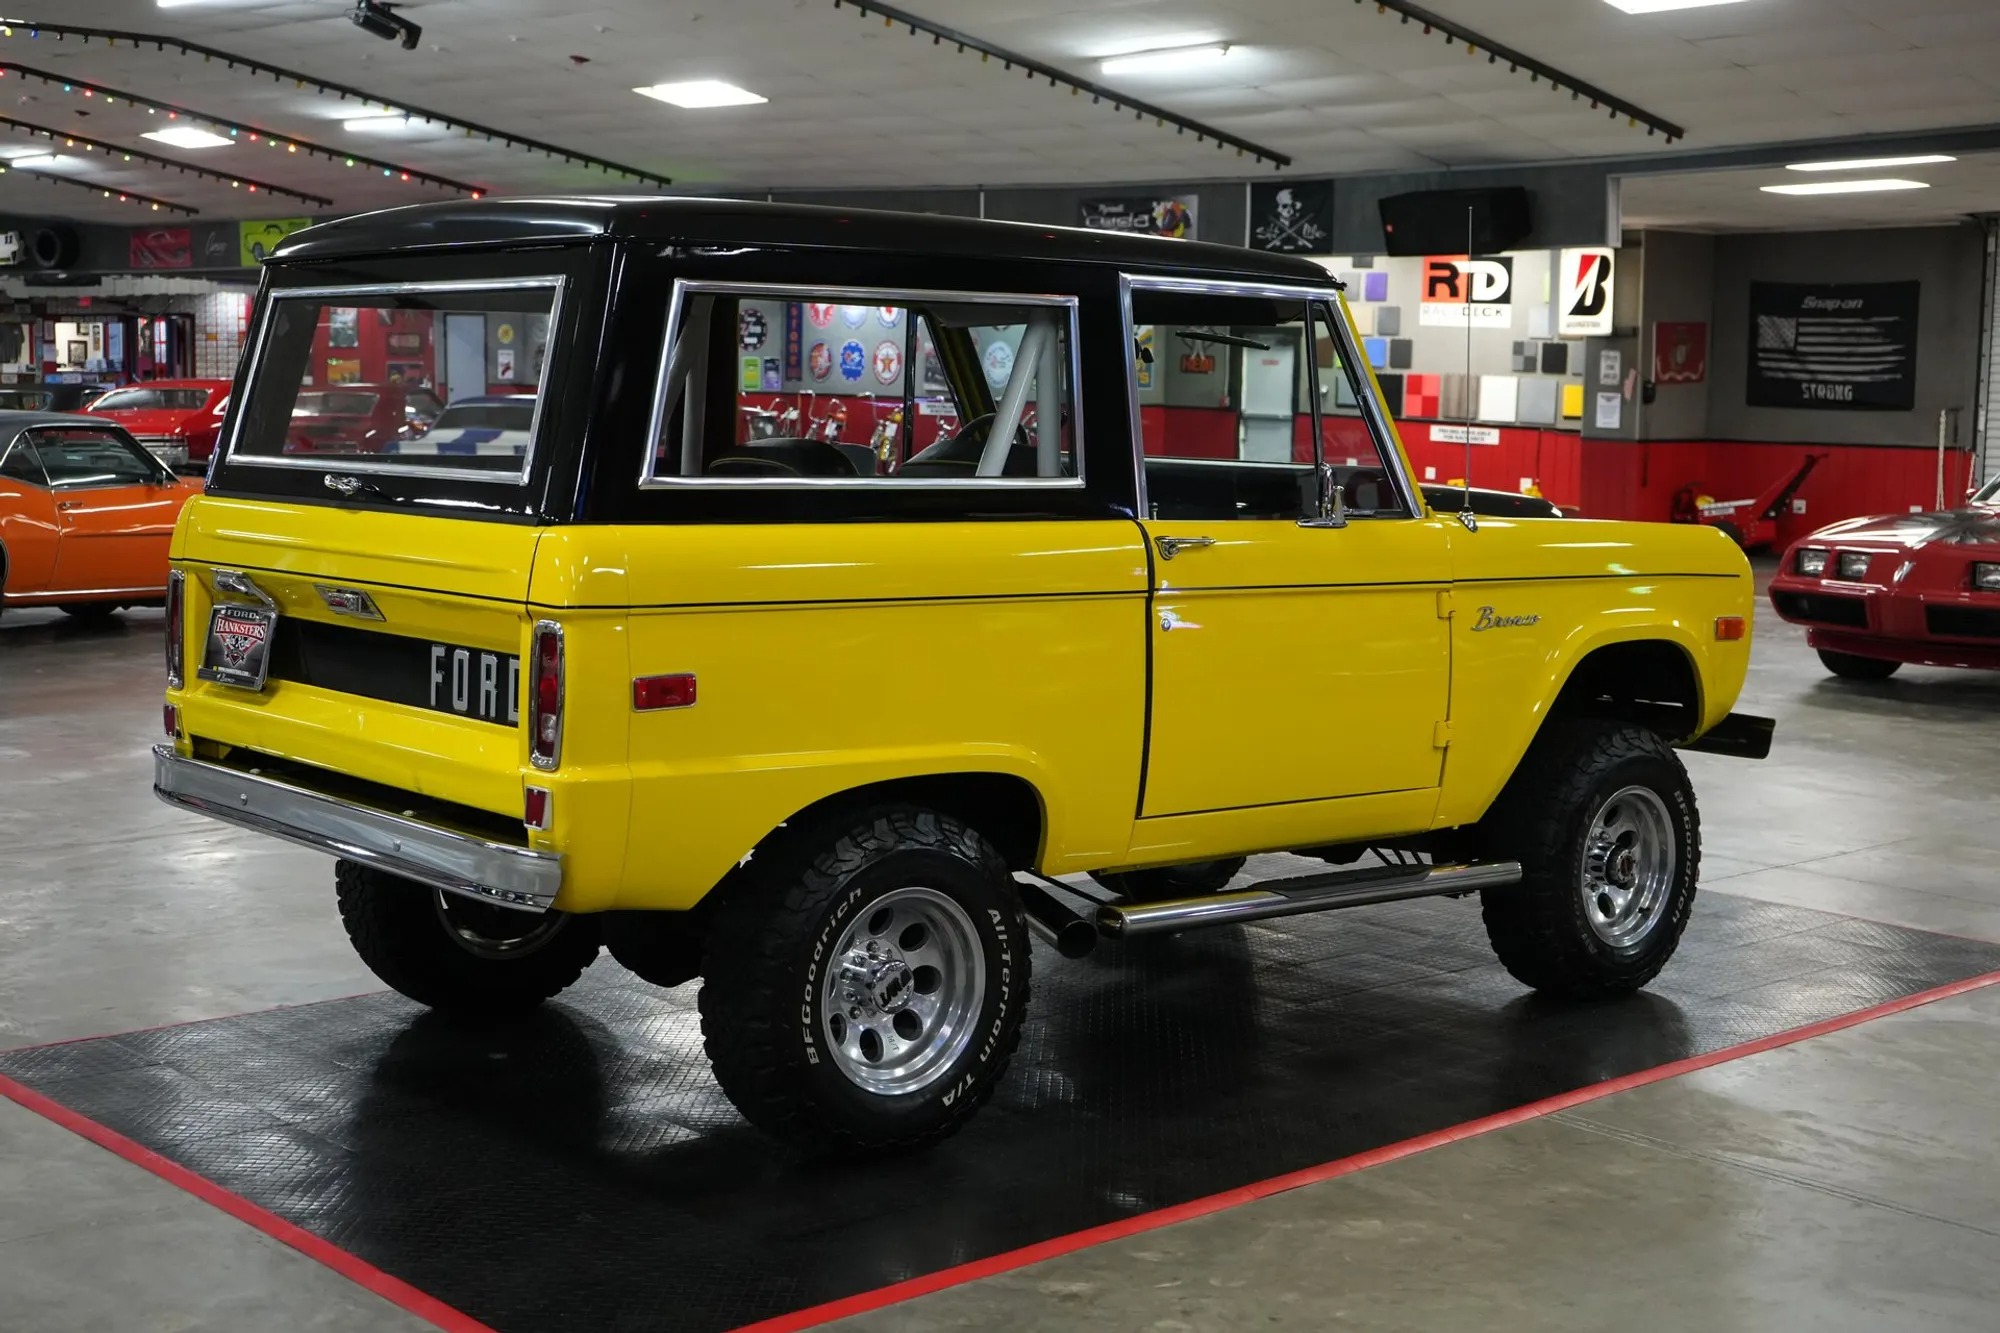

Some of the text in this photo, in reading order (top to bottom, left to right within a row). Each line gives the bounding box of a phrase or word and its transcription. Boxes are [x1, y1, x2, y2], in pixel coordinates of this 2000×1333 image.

[1801, 382, 1853, 401] STRONG
[227, 609, 257, 619] FORD
[1470, 605, 1541, 631] Bronco
[216, 618, 265, 639] HANKSTERS
[1672, 790, 1692, 923] BFGoodrich
[801, 887, 862, 1065] BFGoodrich
[942, 1073, 976, 1106] T/A
